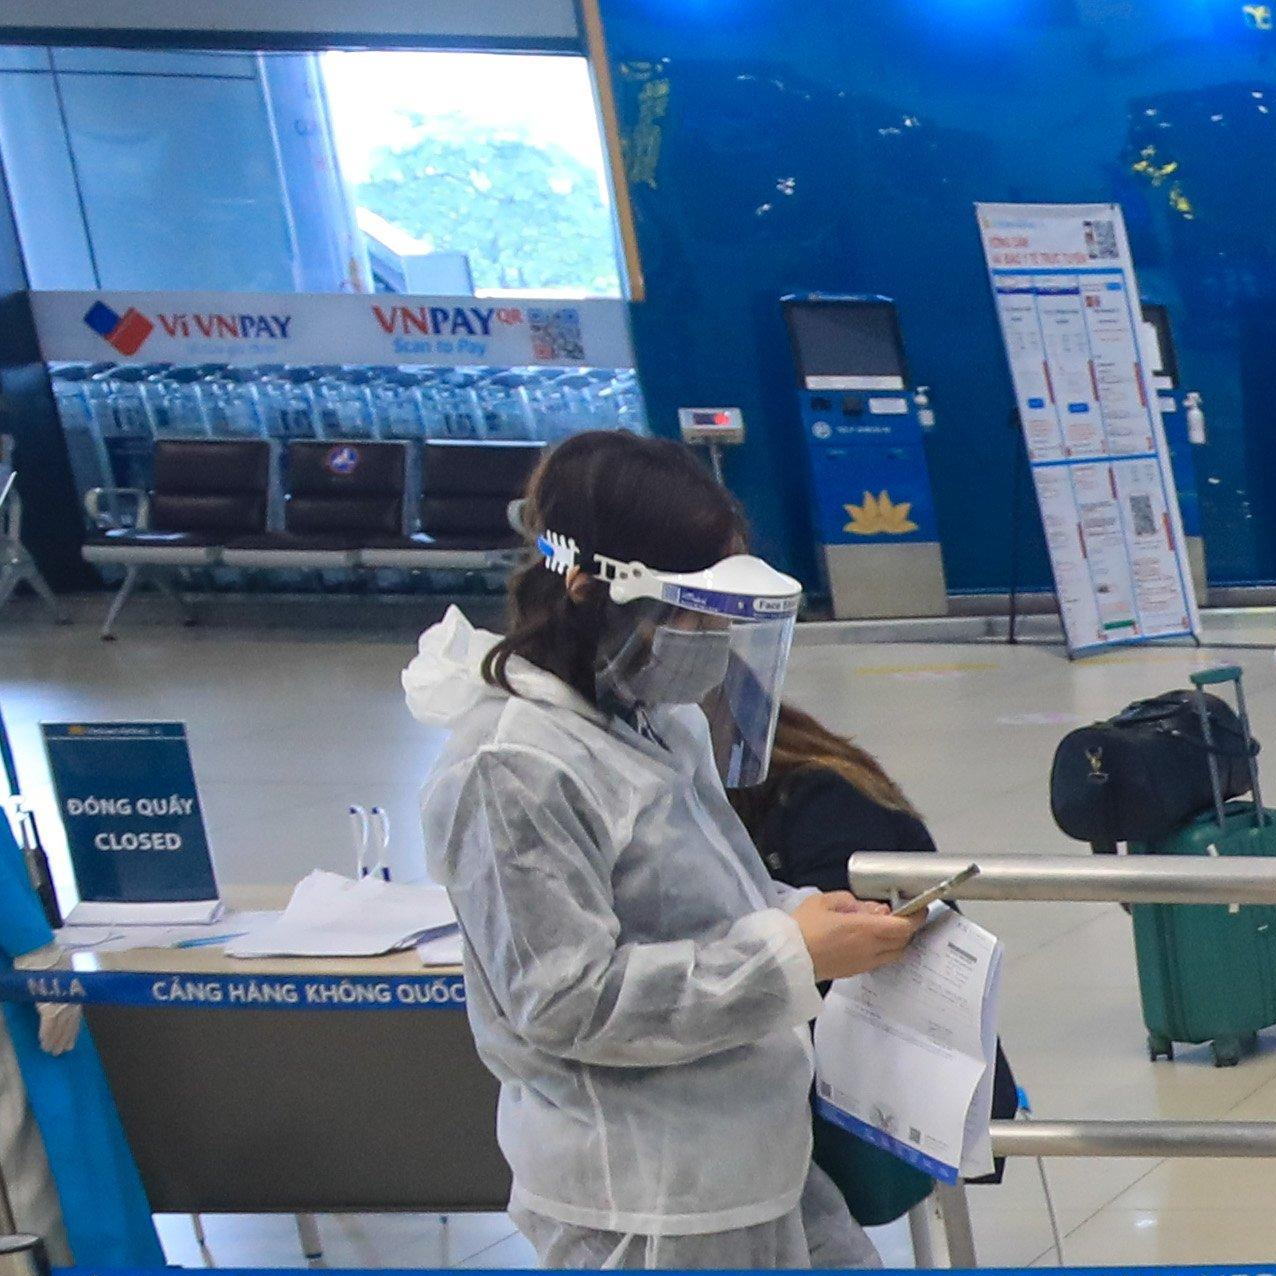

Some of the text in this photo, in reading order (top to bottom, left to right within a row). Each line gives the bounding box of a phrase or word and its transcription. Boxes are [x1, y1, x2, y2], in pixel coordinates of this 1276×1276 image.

[193, 312, 292, 339] VNPAY
[371, 305, 495, 336] VNPAY
[95, 832, 183, 852] CLOSED
[151, 977, 224, 1001] CẢNG
[227, 978, 299, 1002] HÀNG
[304, 977, 391, 1004] KHÔNG
